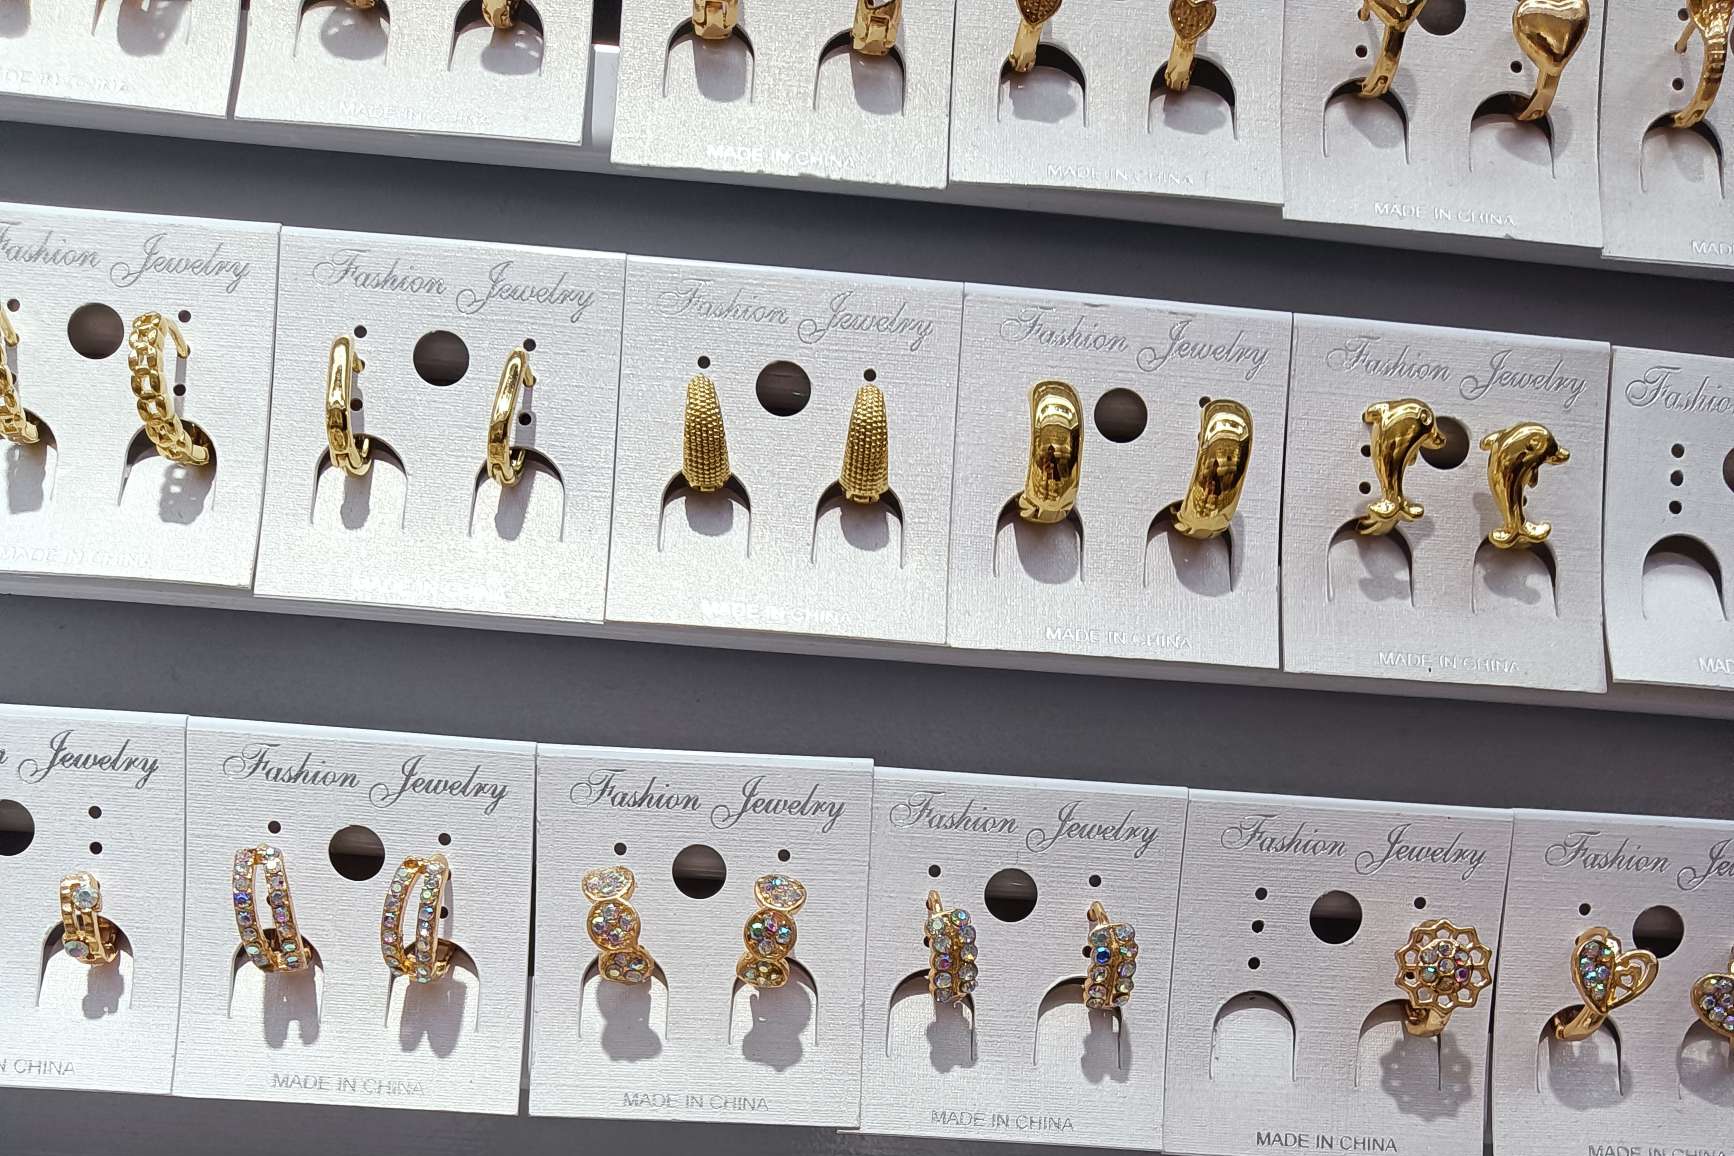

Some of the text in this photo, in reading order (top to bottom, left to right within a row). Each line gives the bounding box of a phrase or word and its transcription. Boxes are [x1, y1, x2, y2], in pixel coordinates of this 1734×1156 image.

[1374, 202, 1518, 227] MADE IN CHINA
[110, 232, 251, 294] Jewelry
[1690, 240, 1734, 256] MAD
[312, 248, 595, 324] Fashion Jewelry
[658, 279, 935, 352] Fashion Jewelry
[1000, 304, 1269, 381] Fashion Jewelry
[1326, 335, 1588, 409] Fashion Jewelry
[1045, 627, 1194, 650] MADE IN CHINA
[1378, 651, 1520, 674] MADE IN CHINA
[18, 729, 159, 790] Jewelry
[222, 743, 508, 816] Fashion Jewelry
[569, 768, 847, 834] Fashion Jewelry
[890, 791, 1158, 859] Fashion Jewelry
[1220, 814, 1488, 881] Fashion Jewelry
[1545, 831, 1671, 872] Fashion
[14, 1058, 76, 1077] CHINA
[271, 1073, 425, 1096] MADE IN CHINA
[623, 1092, 770, 1112] MADE IN CHINA
[931, 1110, 1075, 1132] MADE IN CHINA
[1256, 1131, 1398, 1153] MADE IN CHINA
